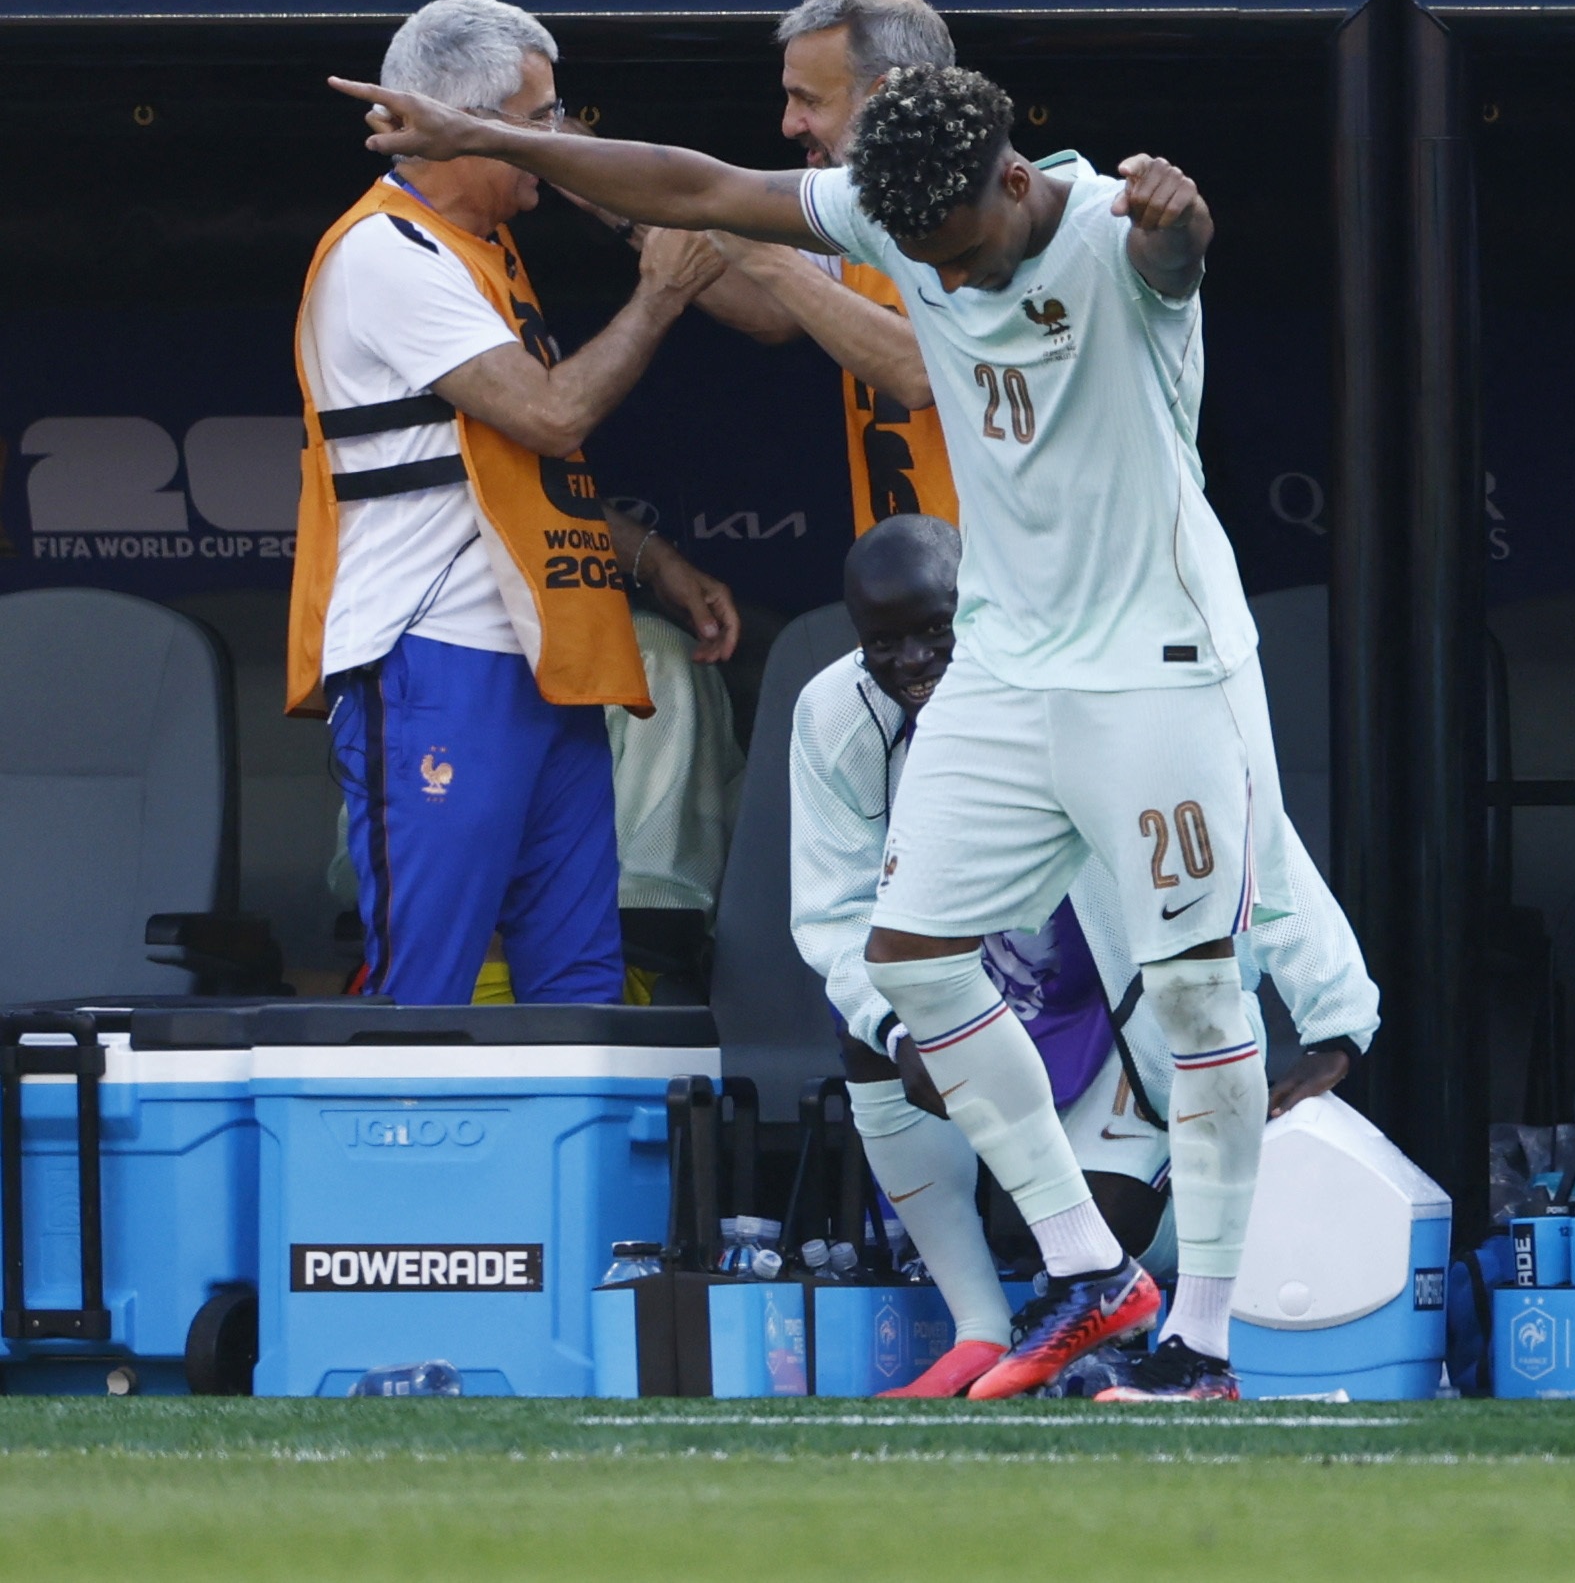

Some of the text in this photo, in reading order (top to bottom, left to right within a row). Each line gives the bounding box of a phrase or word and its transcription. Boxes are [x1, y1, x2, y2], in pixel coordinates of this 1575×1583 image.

[974, 363, 1036, 446] 20
[33, 535, 92, 558] FIFA
[97, 535, 190, 558] WORLD
[198, 535, 251, 558] CUP
[544, 529, 609, 553] WORLD
[1138, 799, 1215, 891] 20
[304, 1250, 529, 1287] POWERADE
